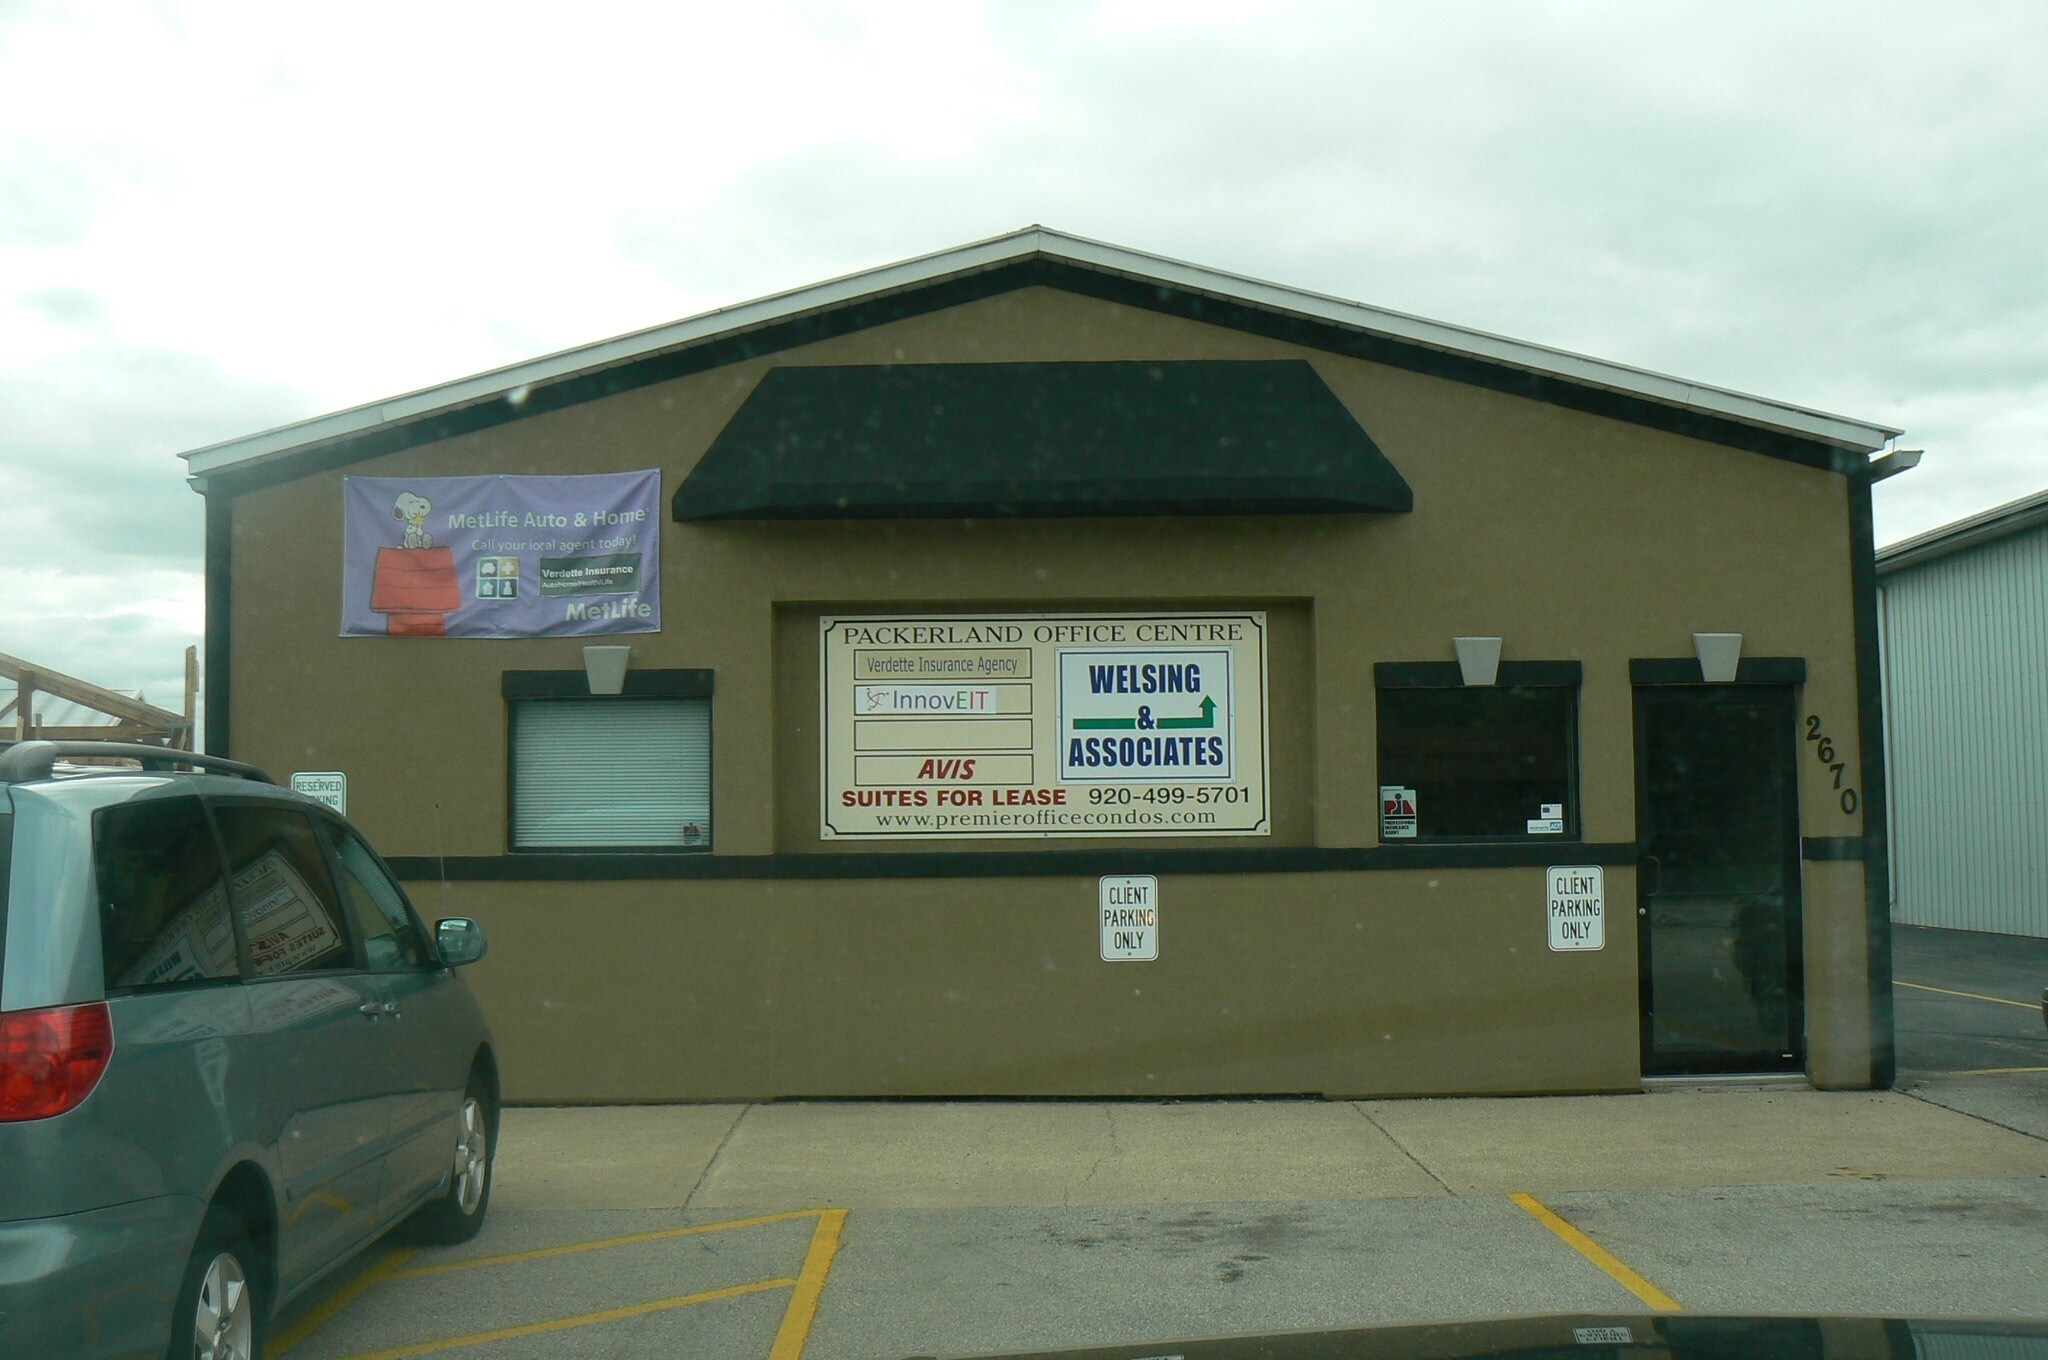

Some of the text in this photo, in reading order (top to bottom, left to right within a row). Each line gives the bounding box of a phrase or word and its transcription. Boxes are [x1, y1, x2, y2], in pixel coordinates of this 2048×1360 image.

[448, 509, 646, 529] MetLife Auto & Home
[472, 534, 637, 553] Call your local agent today!
[542, 566, 634, 578] Verdette Insurance
[565, 598, 652, 621] MetLife
[843, 624, 1243, 645] PACKERLAND OFFICE CENTRE
[867, 656, 1017, 674] Verdette Insurance Agency
[1089, 664, 1200, 693] WELSING
[893, 690, 989, 710] InnovEIT
[1137, 705, 1155, 730] &
[1068, 736, 1224, 767] ASSOCIATES
[917, 759, 976, 780] AVIS
[1805, 715, 1857, 815] 2670
[295, 781, 342, 792] RESERVED
[1088, 786, 1249, 804] 920-499-5701
[842, 789, 1066, 807] SUITES FOR LEASE
[876, 809, 1216, 829] www.premierofficecondos.com
[1556, 877, 1594, 895] CLIENT
[1109, 887, 1148, 904] CLIENT
[1551, 899, 1601, 917] PARKING
[1104, 909, 1154, 927] PARKING
[1561, 921, 1591, 939] ONLY
[1114, 932, 1144, 949] ONLY
